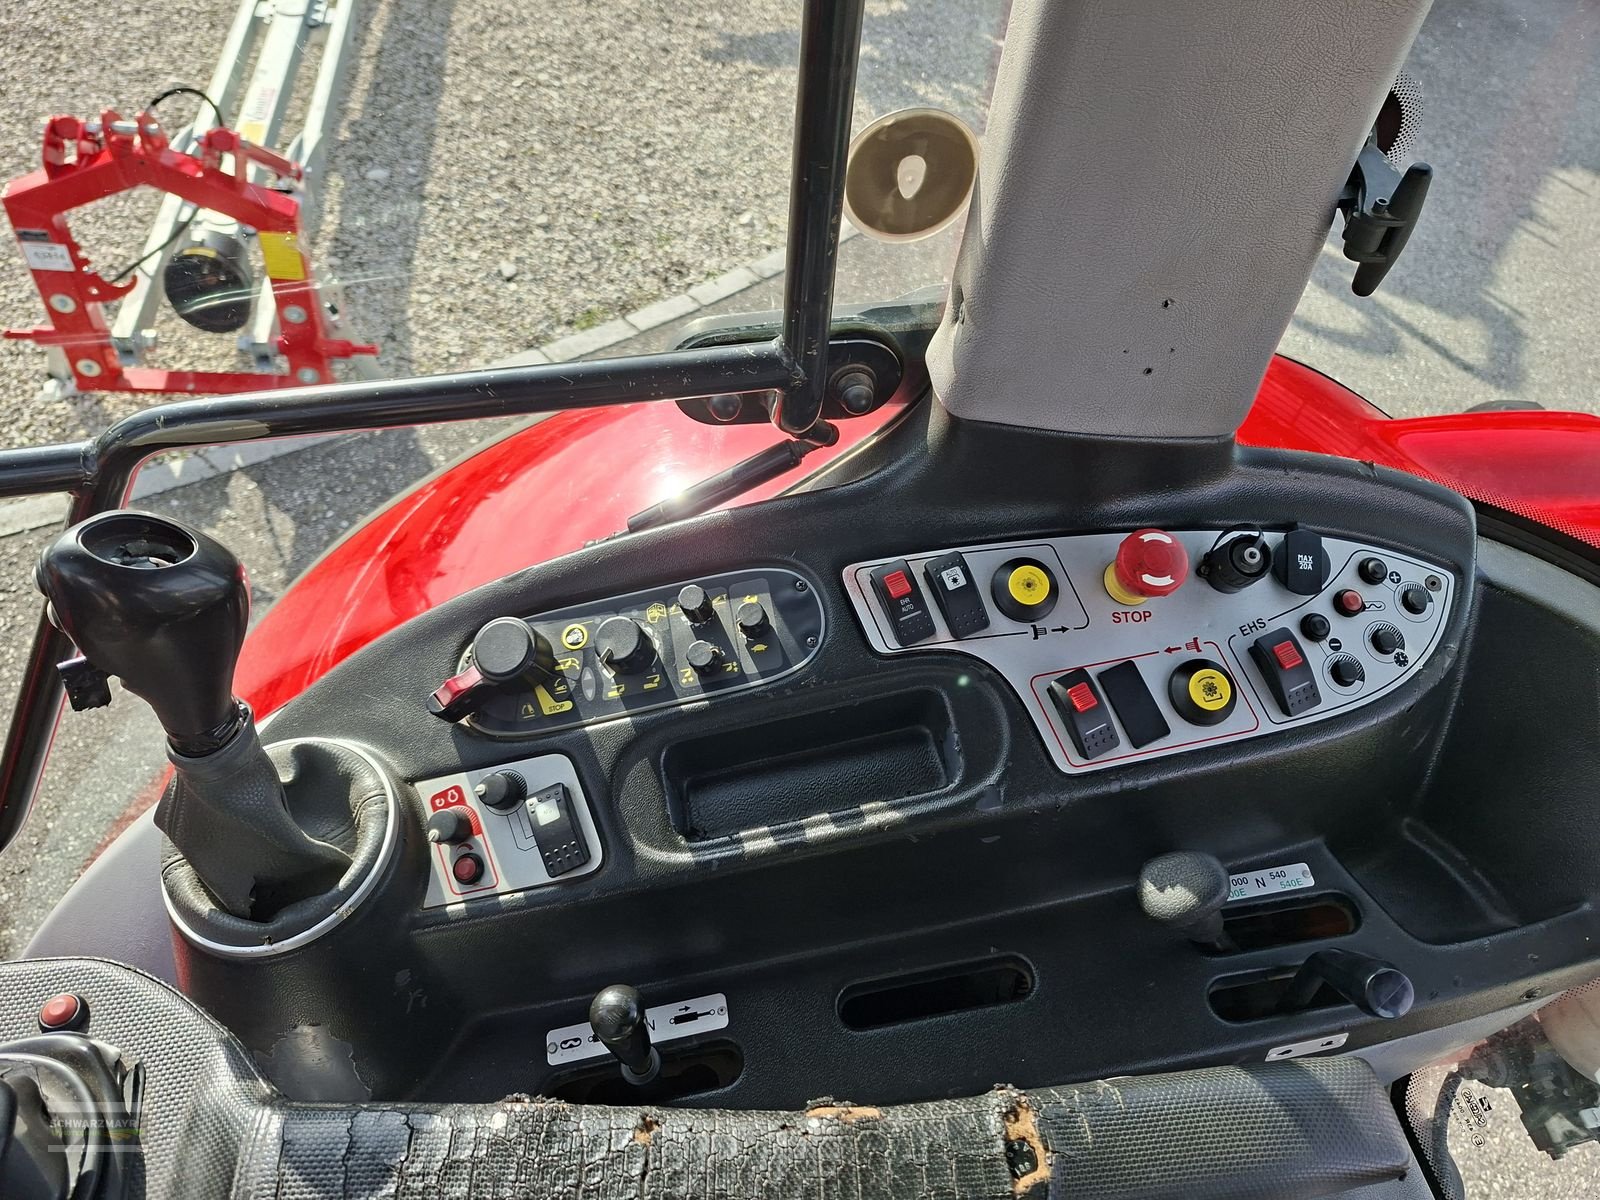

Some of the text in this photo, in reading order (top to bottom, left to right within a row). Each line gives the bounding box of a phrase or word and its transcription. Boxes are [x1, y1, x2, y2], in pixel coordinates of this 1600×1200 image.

[1297, 554, 1313, 562] MAX
[1299, 562, 1313, 571] 20A
[902, 604, 914, 612] AUTO
[1111, 610, 1153, 624] STOP
[1238, 617, 1267, 637] EHS
[548, 703, 565, 713] STOP
[1231, 870, 1287, 889] 000 N 540
[1279, 877, 1304, 889] 540E
